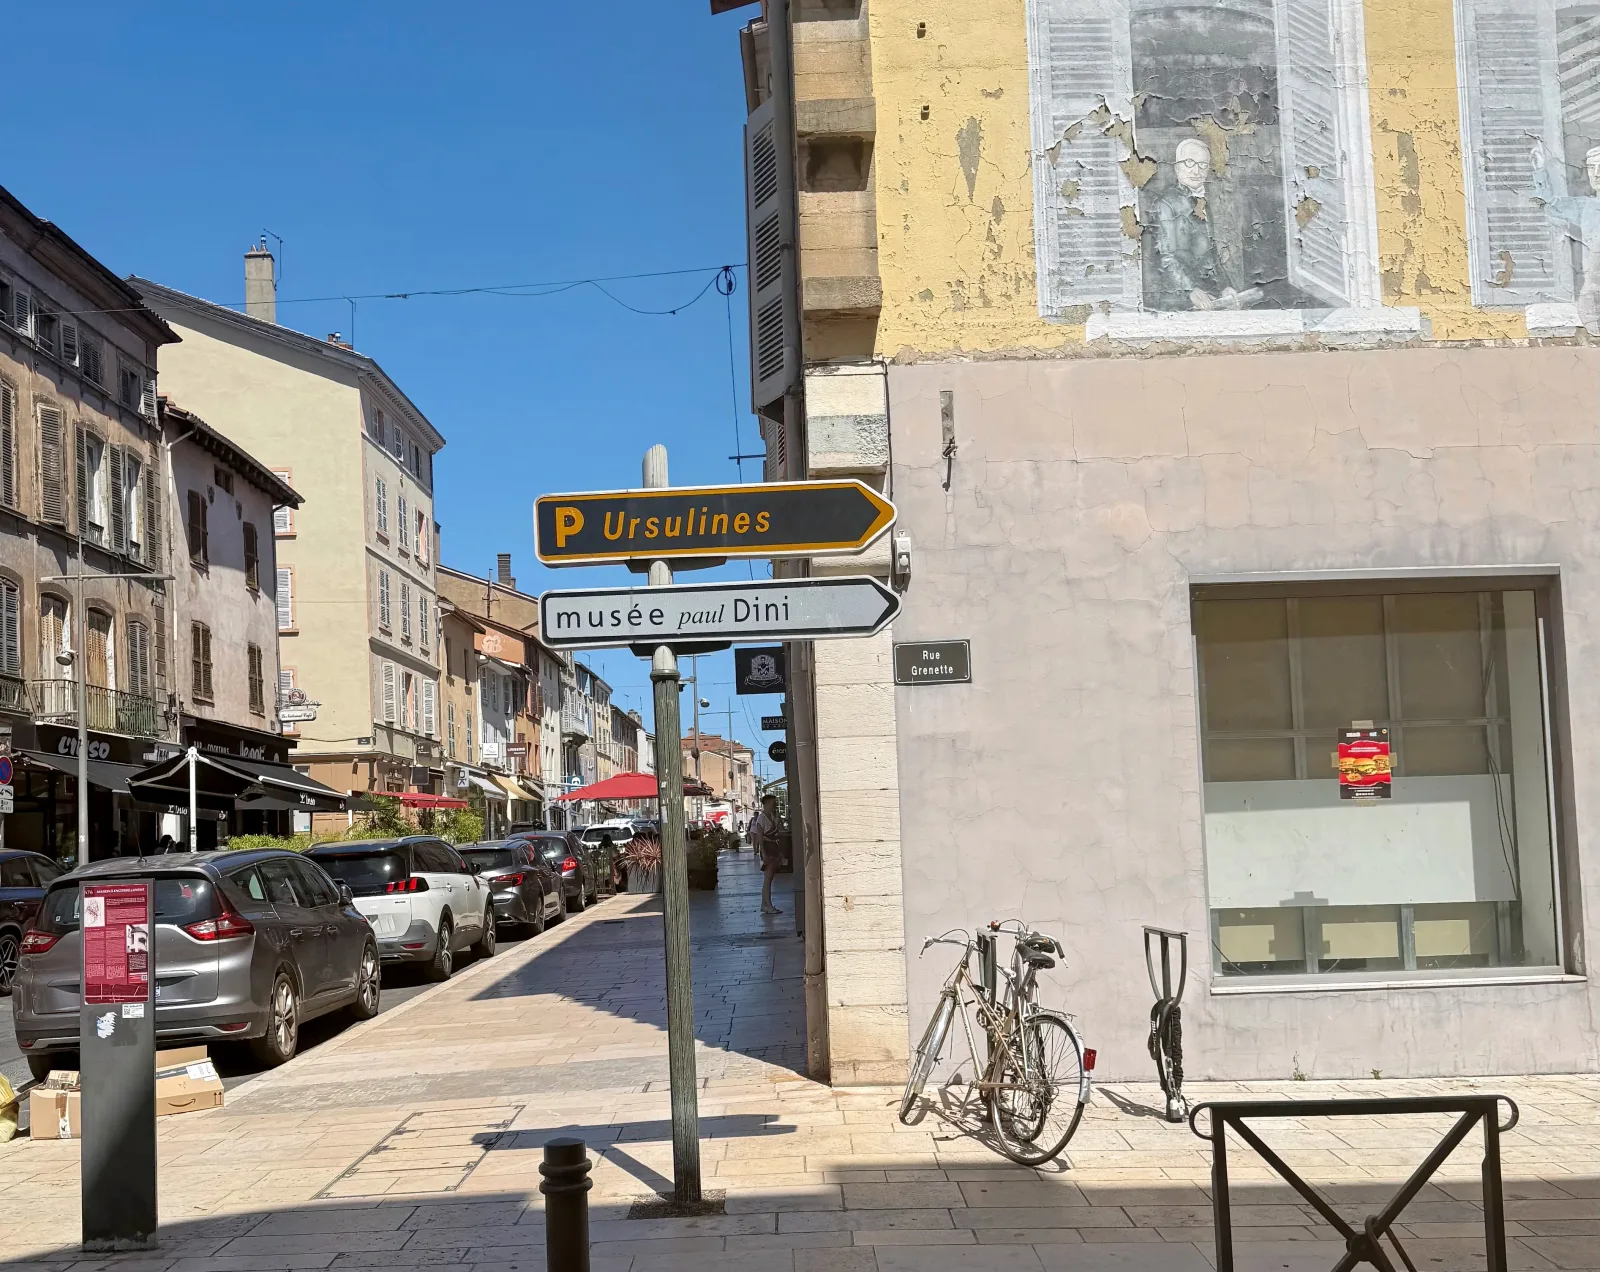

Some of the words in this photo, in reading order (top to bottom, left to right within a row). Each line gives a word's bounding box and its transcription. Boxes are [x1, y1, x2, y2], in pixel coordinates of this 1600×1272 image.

[556, 507, 584, 547] P
[604, 507, 770, 540] Ursulines
[557, 603, 664, 629] musée
[677, 604, 725, 629] paul
[734, 595, 789, 622] Dini
[922, 650, 941, 660] Rue
[911, 665, 954, 676] Grenette
[58, 735, 110, 759] L'ISO
